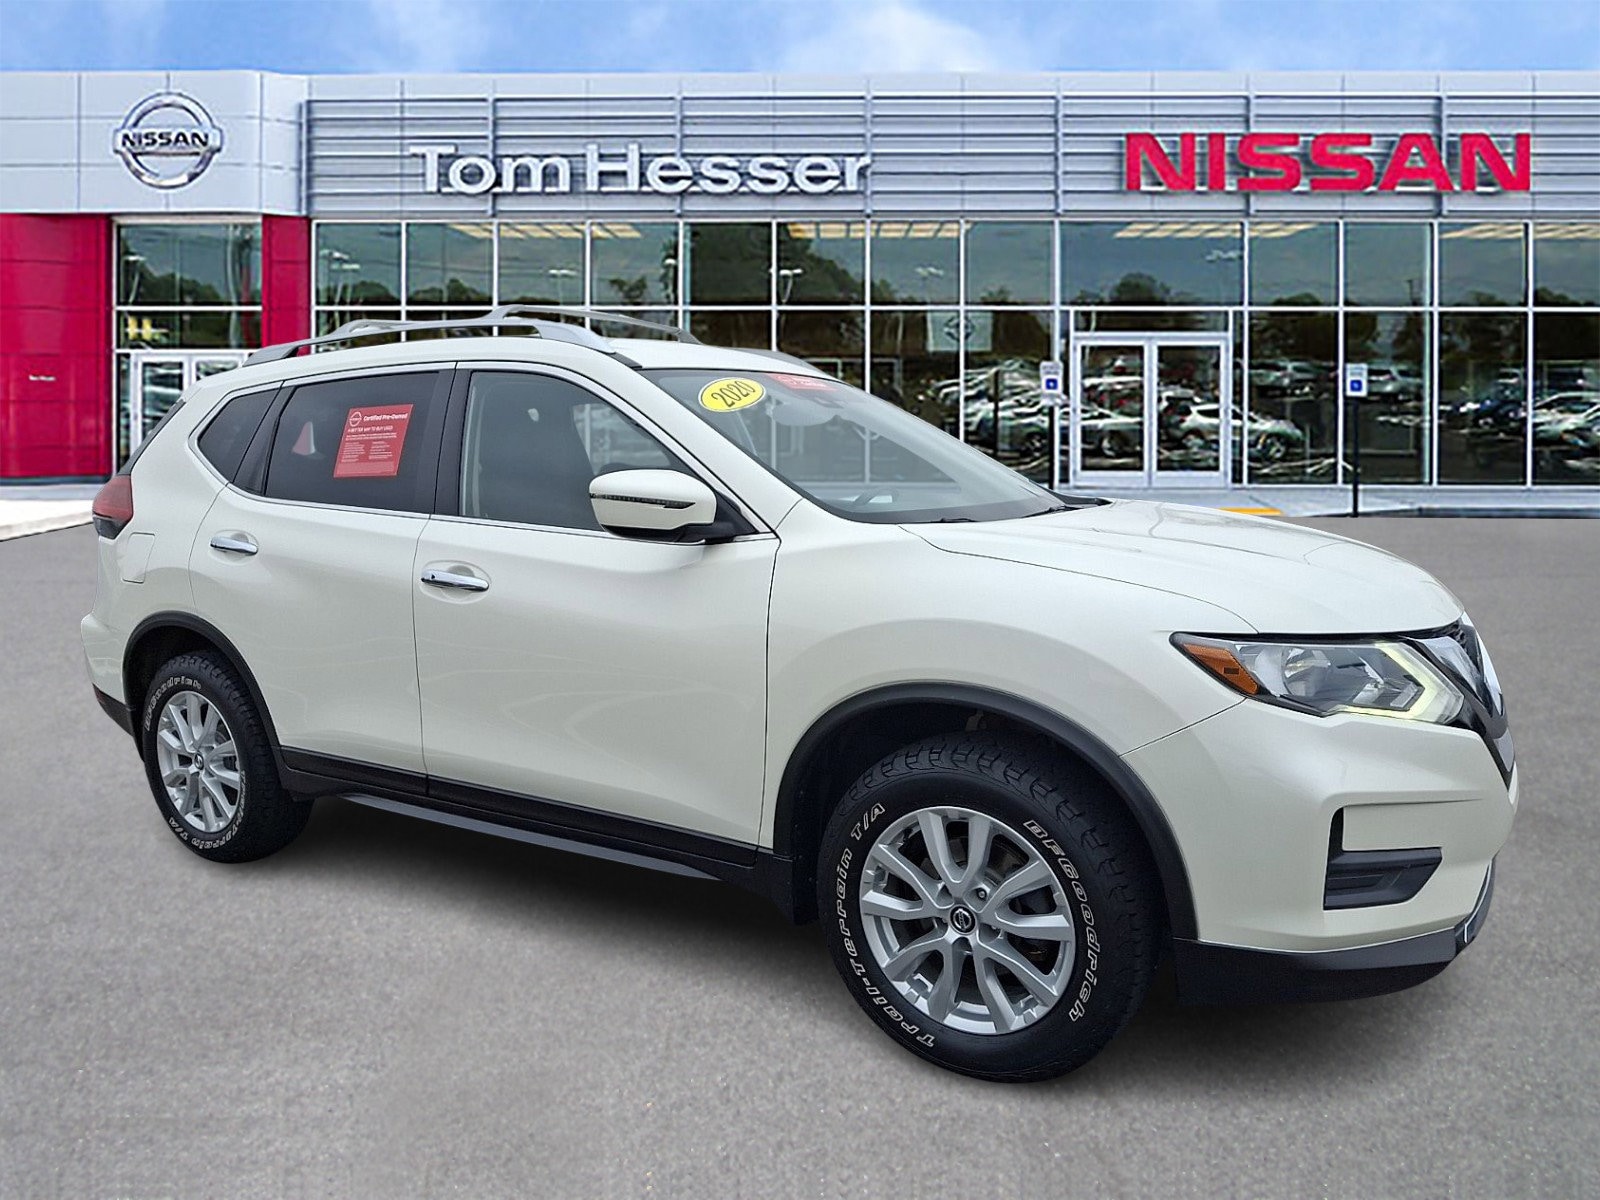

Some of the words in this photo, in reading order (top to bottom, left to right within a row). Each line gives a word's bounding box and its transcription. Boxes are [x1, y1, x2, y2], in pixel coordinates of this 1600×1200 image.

[121, 131, 209, 148] NISSAN
[409, 144, 571, 194] Tom
[585, 142, 871, 194] Hesser
[1125, 132, 1531, 191] NISSAN
[711, 380, 756, 407] 2020
[363, 414, 382, 422] Certified
[850, 803, 885, 841] T/A
[1023, 820, 1100, 1022] BFGoodrich
